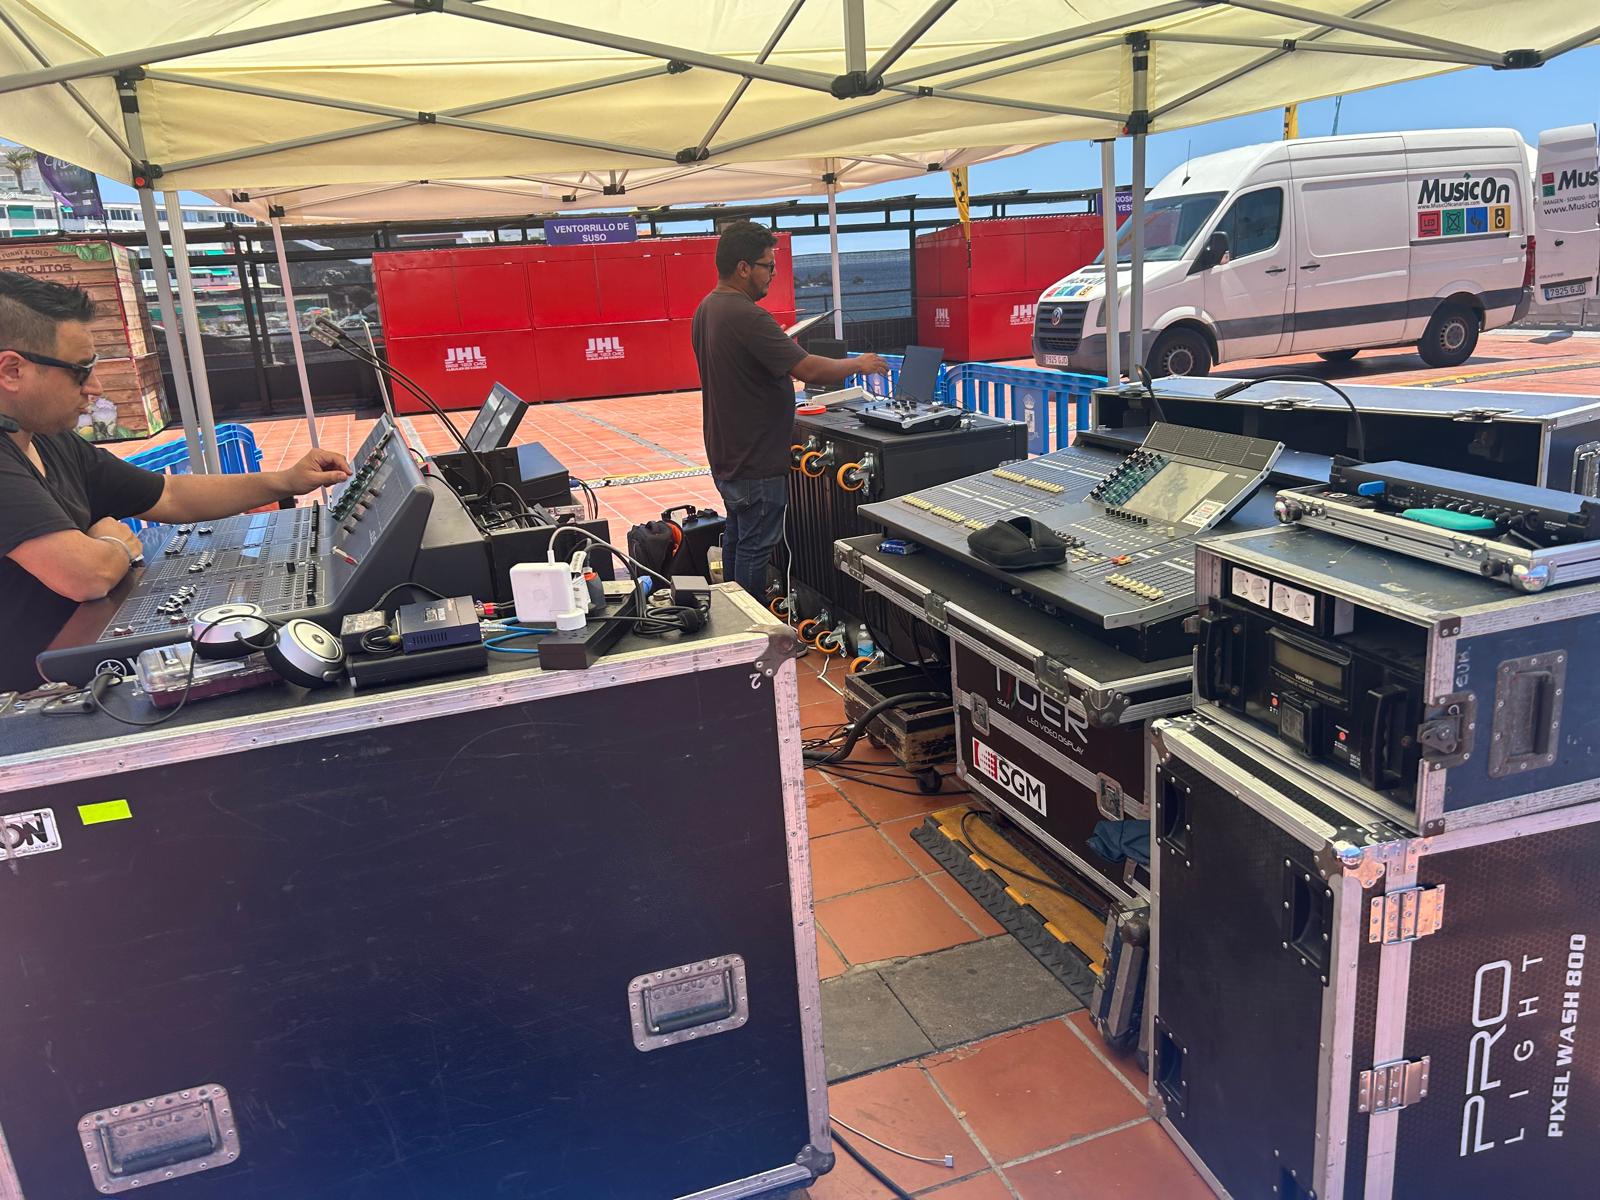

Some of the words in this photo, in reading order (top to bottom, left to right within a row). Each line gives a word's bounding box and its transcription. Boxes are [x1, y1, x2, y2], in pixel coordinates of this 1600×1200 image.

[1544, 200, 1598, 215] www.MusicO
[554, 223, 615, 234] VENTORRILLO
[617, 222, 630, 231] DE
[582, 233, 607, 242] SUSO
[16, 263, 73, 275] MOJITOS
[1550, 286, 1569, 297] 7925
[445, 347, 486, 363] JHL
[585, 337, 624, 352] JHL
[1026, 714, 1039, 728] LED
[1040, 723, 1058, 739] VIDEO
[1058, 734, 1084, 755] DISPLAY
[999, 761, 1042, 810] SGM
[1566, 934, 1587, 987] 800
[1556, 992, 1580, 1066] WASH
[1460, 959, 1512, 1157] PRO
[1504, 955, 1543, 1144] LIGHT
[1548, 1070, 1571, 1137] PIXEL
